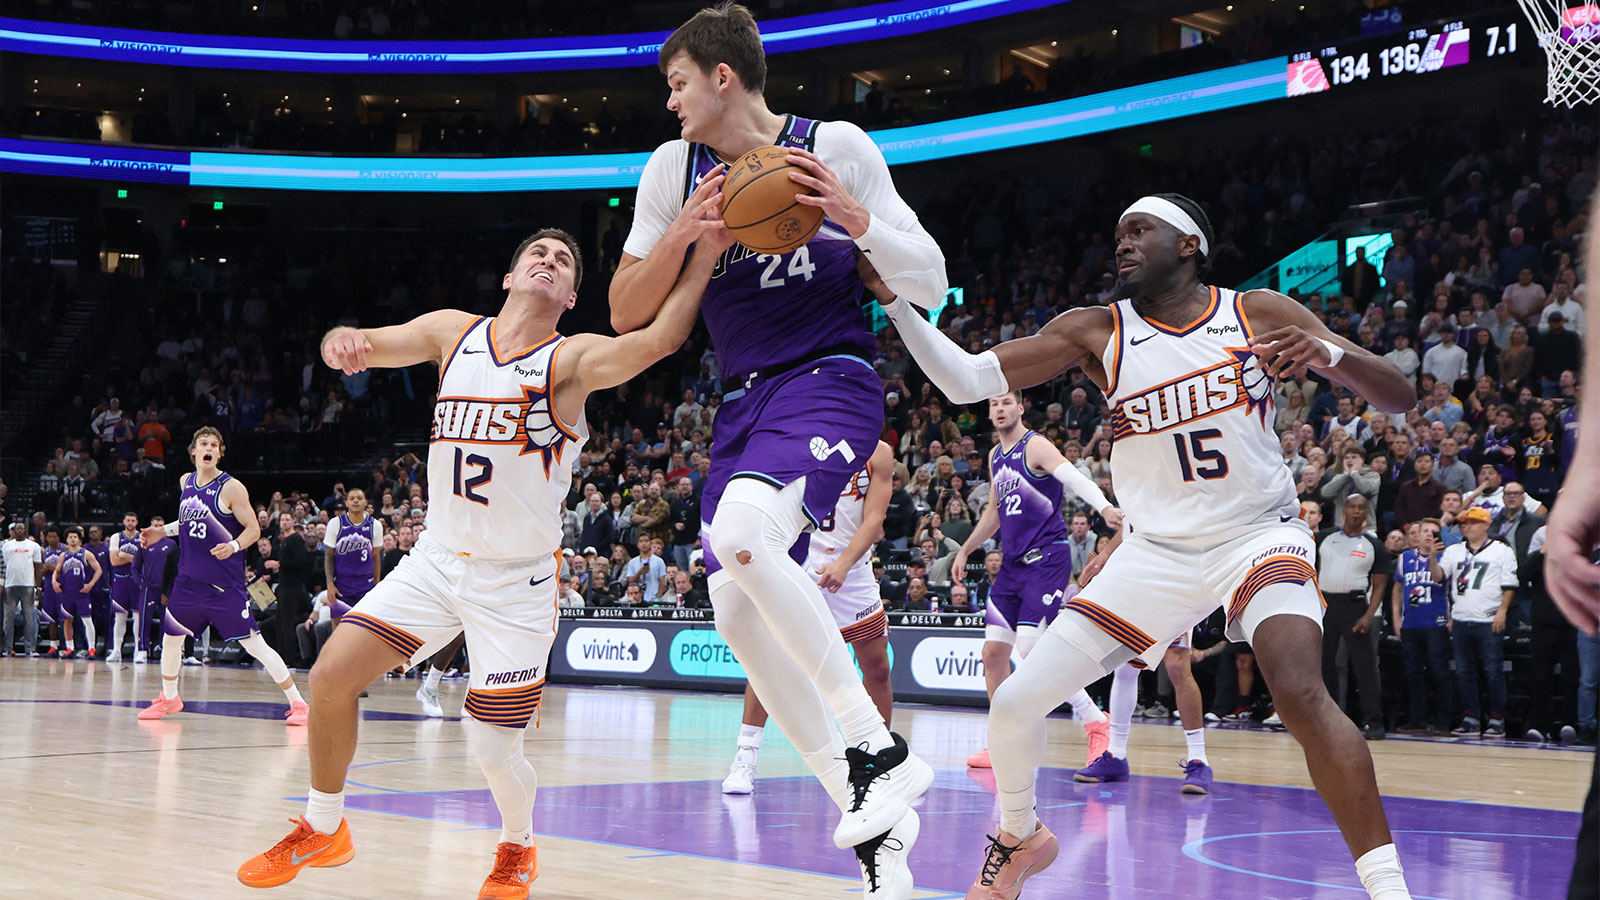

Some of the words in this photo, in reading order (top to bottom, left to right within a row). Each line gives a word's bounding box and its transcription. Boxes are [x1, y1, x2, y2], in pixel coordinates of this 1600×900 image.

[116, 40, 183, 55] visionary
[1486, 23, 1516, 57] 7.1
[384, 52, 447, 62] visionary
[1379, 43, 1420, 76] 136
[1330, 53, 1370, 85] 134
[106, 159, 173, 173] visionary
[756, 244, 816, 289] 24
[1207, 325, 1239, 336] PayPal
[514, 364, 544, 378] PayPal
[1122, 365, 1238, 433] SUNS
[434, 401, 521, 441] SUNS
[1173, 429, 1229, 482] 15
[453, 446, 494, 507] 12
[179, 504, 209, 525] UTAH
[1005, 494, 1022, 516] 22
[189, 520, 207, 539] 23
[339, 540, 370, 555] UTAH
[361, 549, 368, 562] 3
[1252, 545, 1308, 567] PHOENIX
[73, 567, 81, 576] 13
[563, 609, 585, 617] DELTA
[601, 609, 623, 617] DELTA
[639, 609, 663, 618] DELTA
[680, 610, 704, 618] DELTA
[911, 615, 942, 624] DELTA
[965, 616, 985, 626] DEL
[680, 643, 740, 664] PROTE
[936, 650, 986, 677] vivin
[485, 665, 540, 686] PHOENIX
